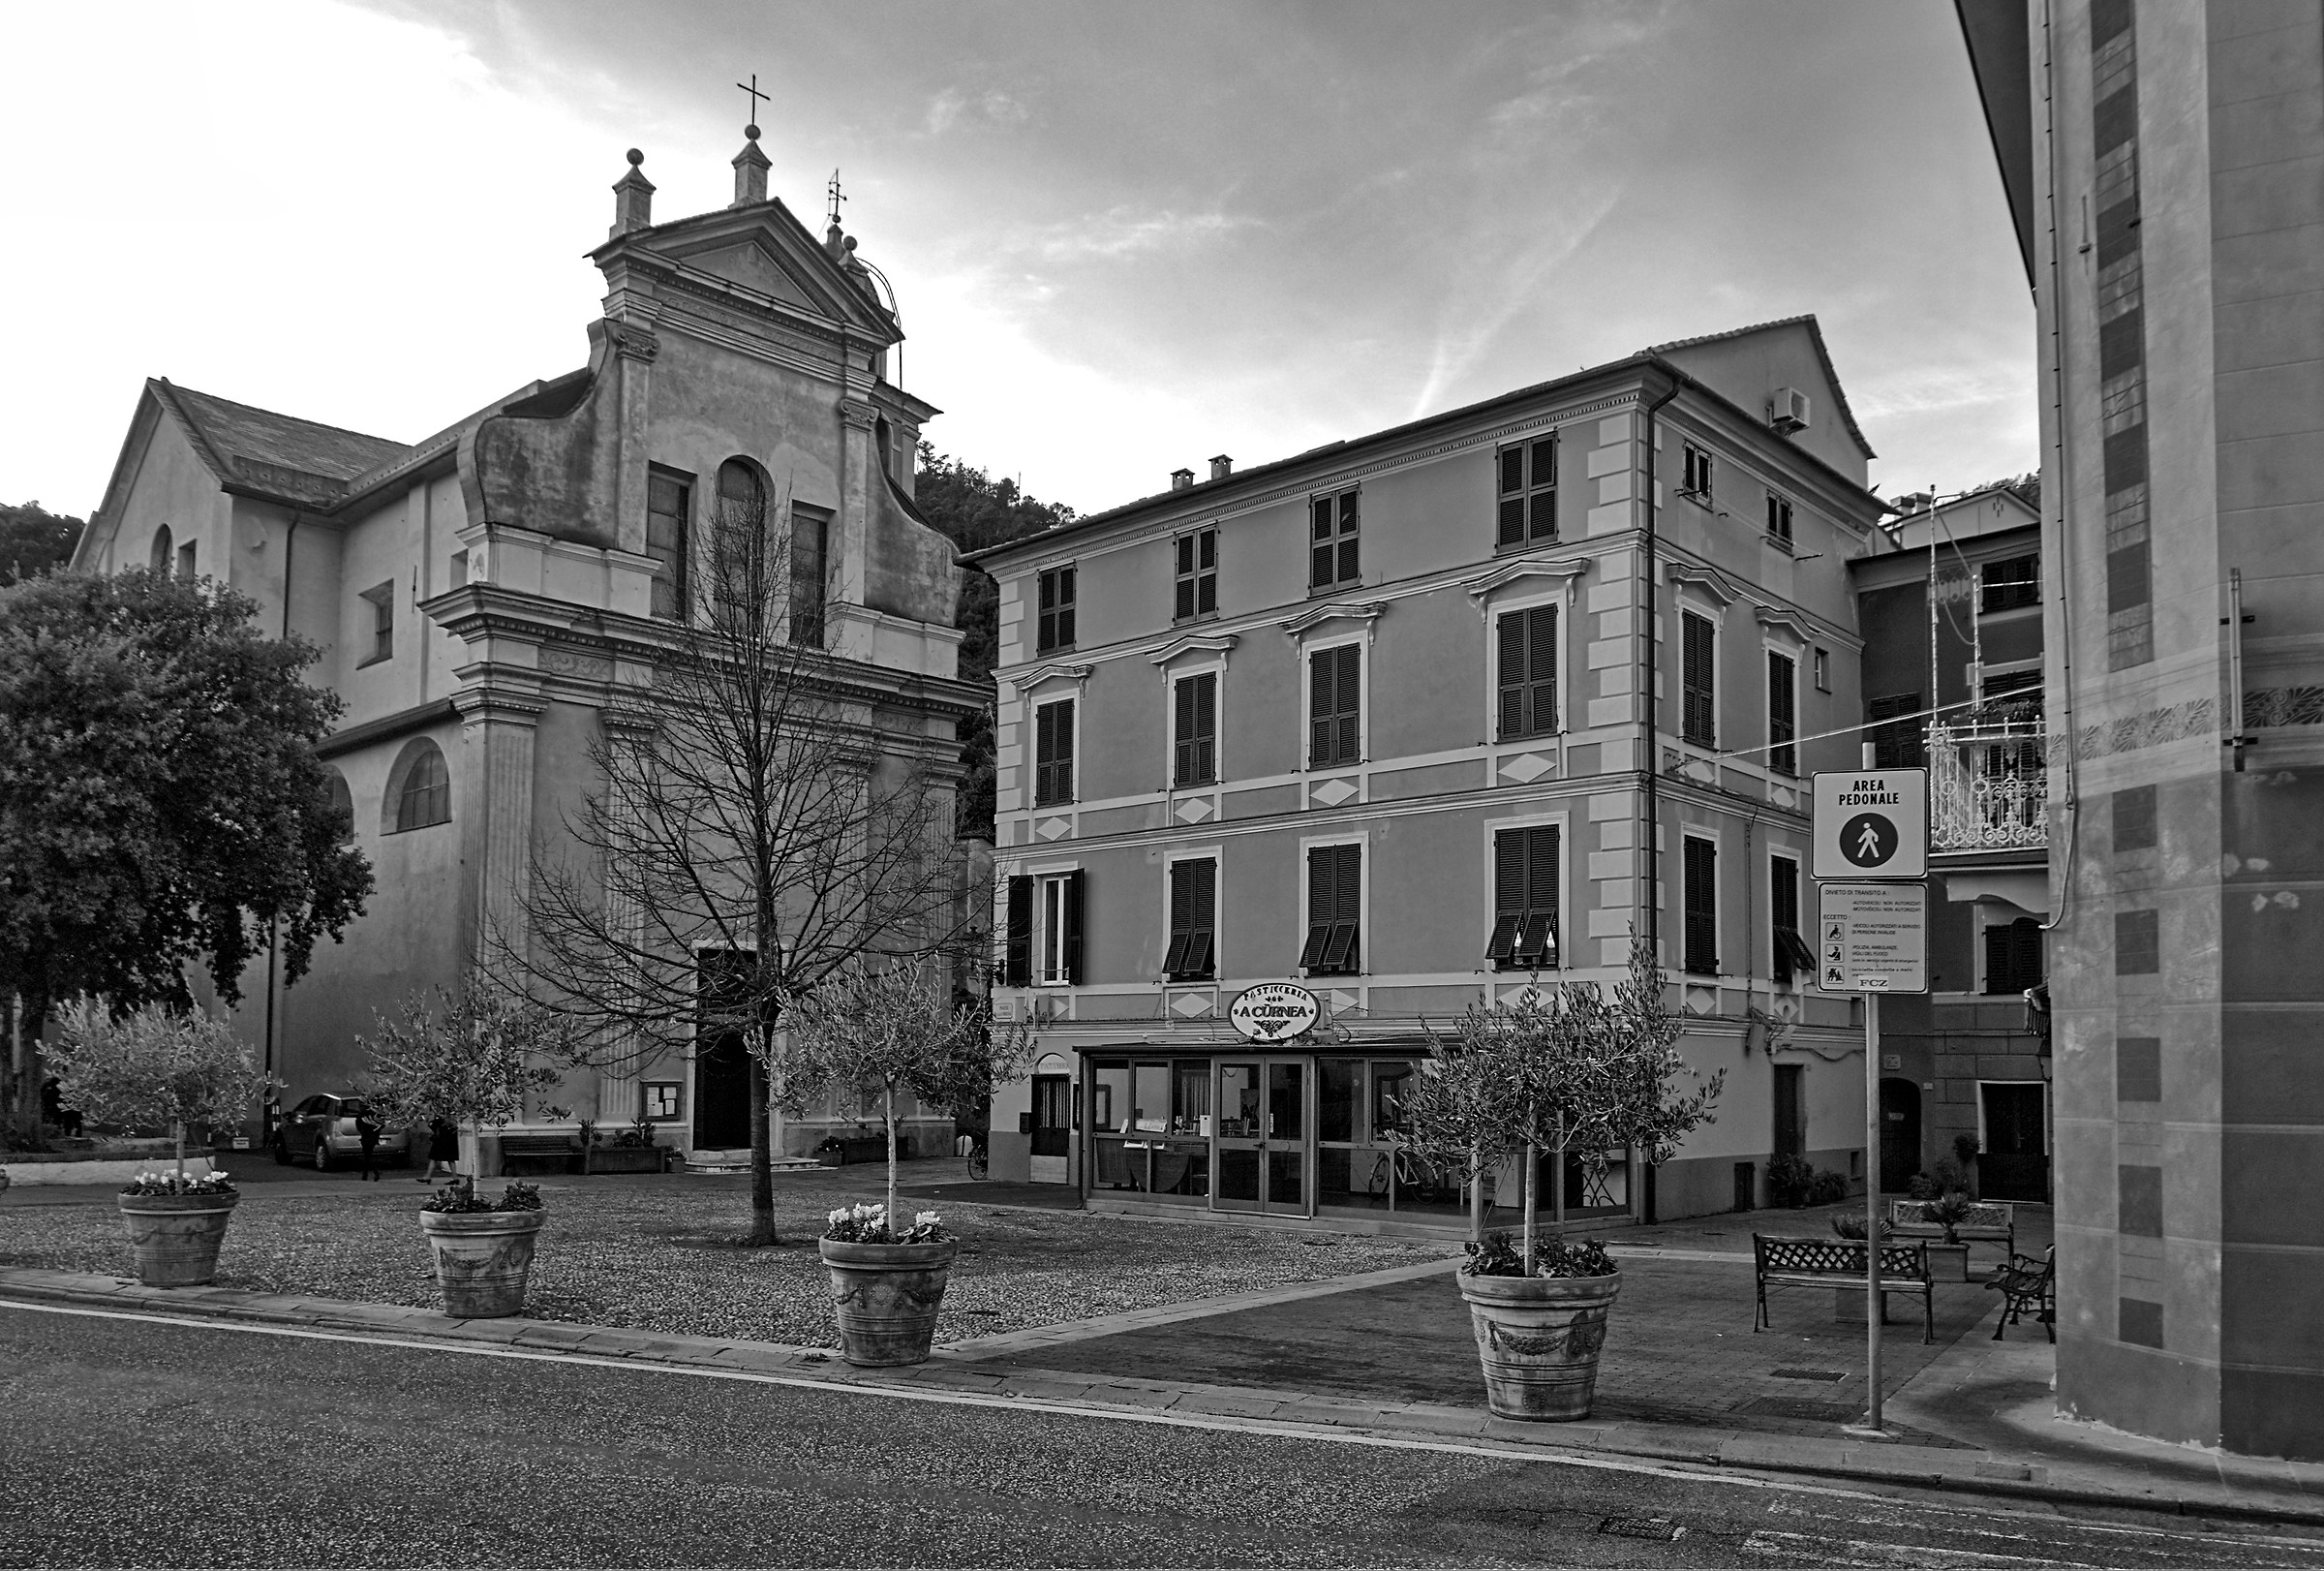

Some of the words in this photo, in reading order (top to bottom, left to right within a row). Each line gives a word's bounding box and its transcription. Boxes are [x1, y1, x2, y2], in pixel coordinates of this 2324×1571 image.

[1852, 780, 1885, 791] AREA
[1838, 792, 1900, 806] PEDONALE
[1243, 986, 1307, 1001] PASTICCERIA
[1239, 1006, 1251, 1017] A
